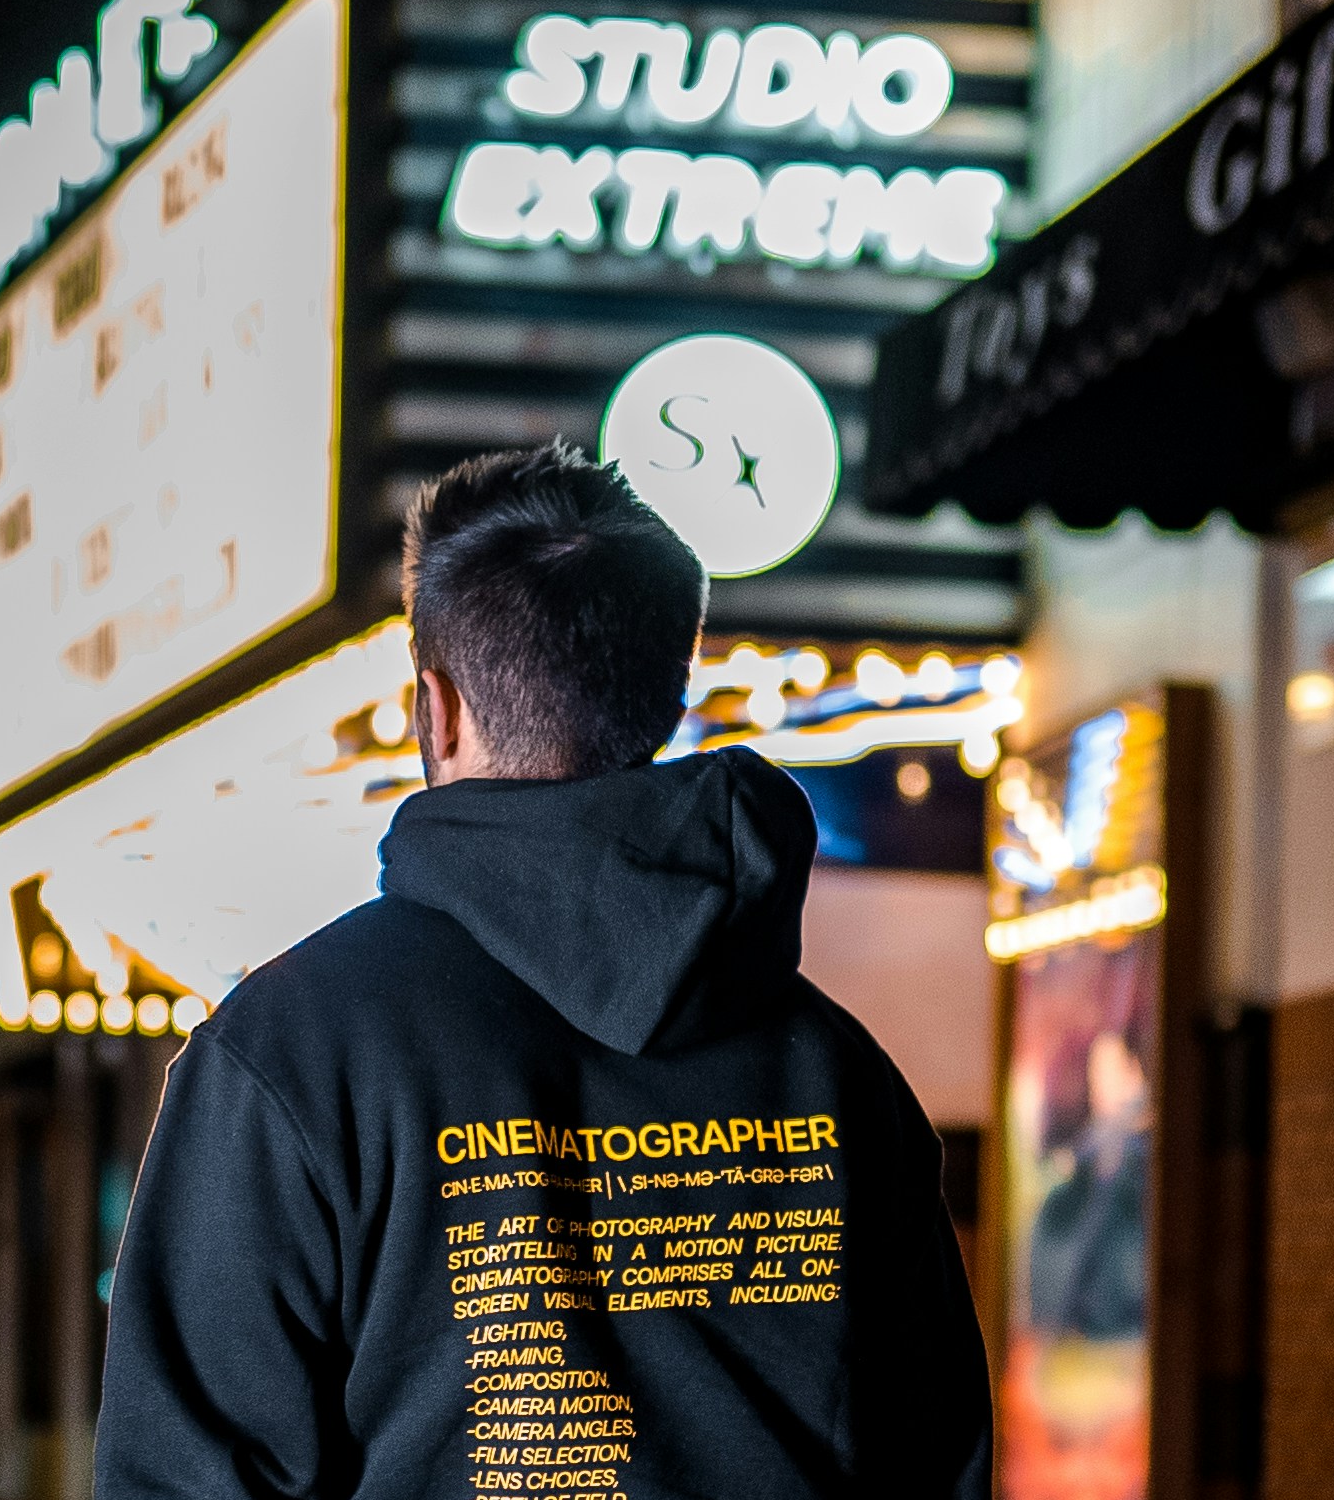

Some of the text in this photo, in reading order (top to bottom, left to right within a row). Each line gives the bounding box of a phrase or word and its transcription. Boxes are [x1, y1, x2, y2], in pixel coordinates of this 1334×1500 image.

[505, 13, 954, 140] STUDIO
[442, 141, 1008, 280] EXTREME
[437, 1115, 839, 1165] CINEMATOGRAPHER
[445, 1208, 845, 1245] THE ART OF PHOTOGRAPHY AND VISUAL
[447, 1233, 843, 1270] STORYTELLING IN A MOTION PICTURE.
[451, 1258, 841, 1295] CINEMATOGRAPHY COMPRISES ALL ON-
[452, 1284, 841, 1320] SCREEN VISUAL ELEMENTS, INCLUDING:
[466, 1320, 568, 1345] -LIGHTING,
[464, 1346, 566, 1370] -FRAMING,
[464, 1370, 611, 1394] -COMPOSITION,
[466, 1395, 634, 1416] -CAMERA MOTION,
[466, 1419, 637, 1441] -CAMERA ANGLES,
[467, 1443, 632, 1466] -FILM SELECTION,
[468, 1468, 619, 1490] -LENS CHOICES,
